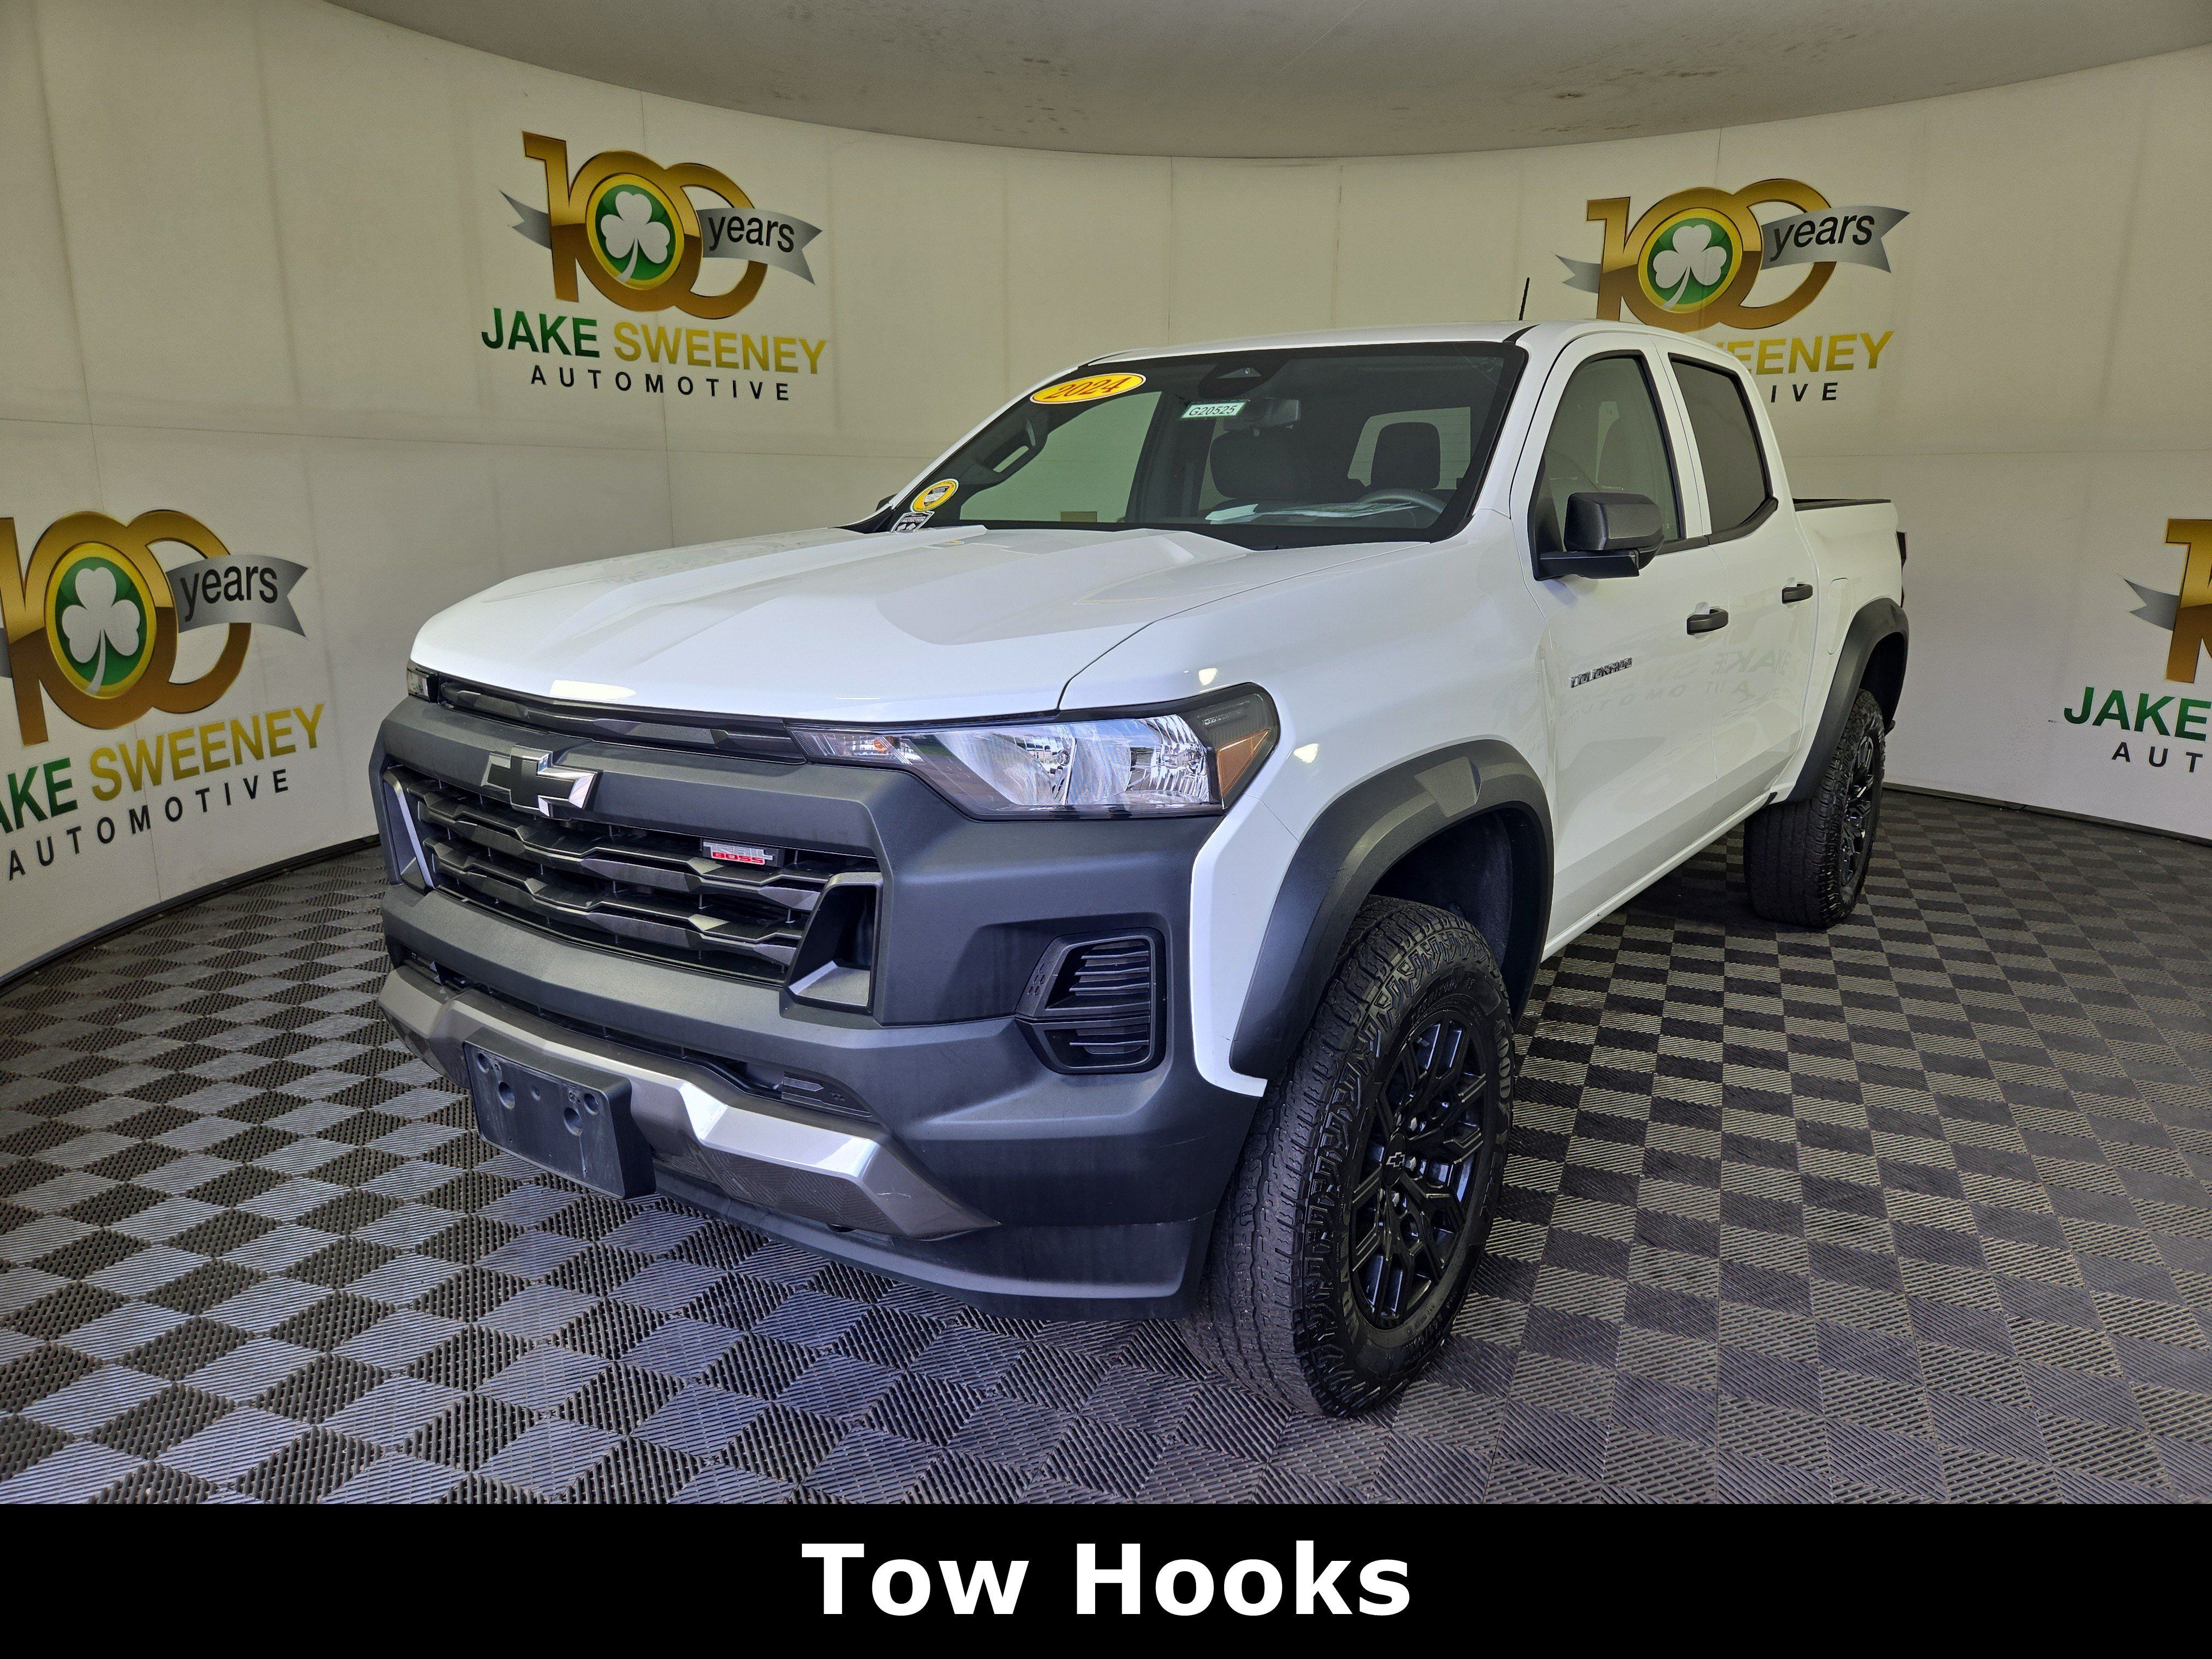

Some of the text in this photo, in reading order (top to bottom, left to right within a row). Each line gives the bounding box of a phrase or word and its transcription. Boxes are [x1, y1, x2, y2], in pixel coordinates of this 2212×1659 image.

[708, 215, 795, 253] years
[1770, 214, 1875, 262] years
[481, 307, 827, 375] JAKE SWEENEY
[1715, 330, 1894, 375] EENEY
[530, 365, 789, 401] AUTOMOTIVE
[1043, 376, 1132, 400] 2024
[1189, 405, 1238, 416] G20525
[180, 565, 278, 622] years
[2063, 686, 2212, 742] JAKE
[89, 704, 325, 801] SWEENEY
[9, 769, 290, 881] AUTOMOTIVE
[703, 841, 773, 860] TRAIL
[712, 851, 765, 865] BOSS
